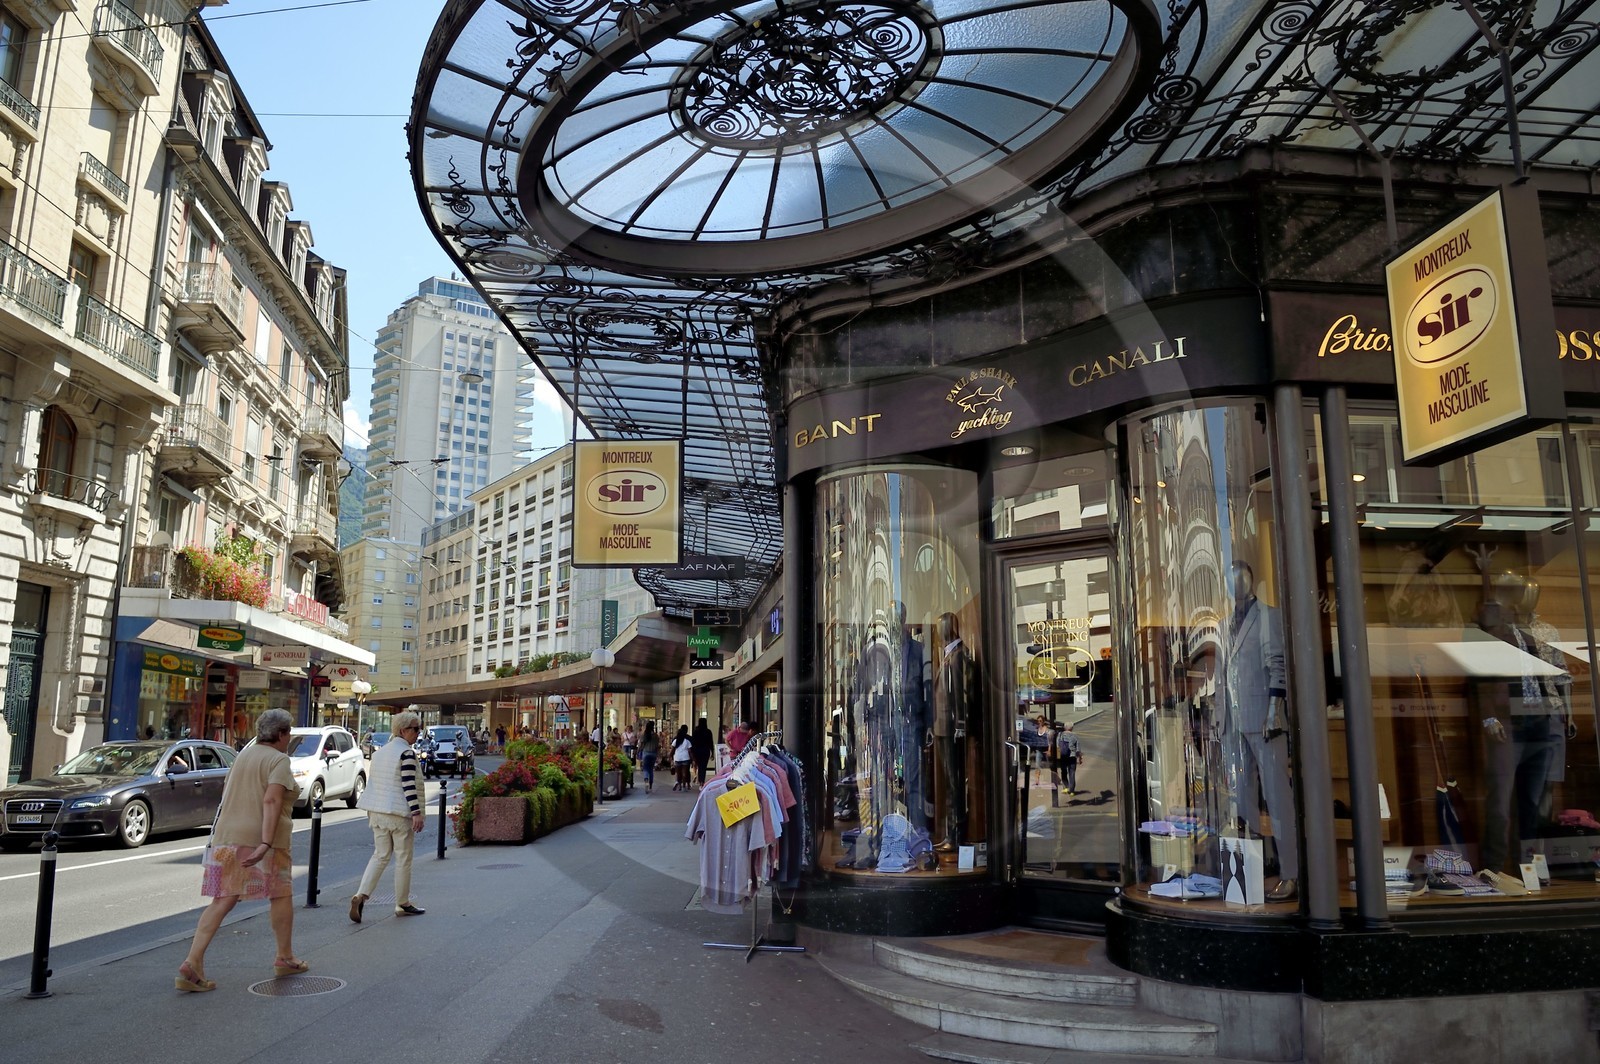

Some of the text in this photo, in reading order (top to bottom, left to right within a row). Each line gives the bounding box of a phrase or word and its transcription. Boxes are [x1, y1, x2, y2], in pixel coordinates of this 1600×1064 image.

[1414, 229, 1472, 283] MONTREUX
[1417, 287, 1483, 348] sir
[1317, 314, 1392, 357] Brio
[1068, 335, 1188, 388] CANALI
[945, 367, 1018, 403] PAUL & SHARK
[1439, 362, 1472, 396] MODE
[1428, 379, 1490, 425] MASCULINE
[793, 412, 883, 449] GANT
[950, 407, 1013, 439] yachting
[602, 451, 653, 464] MONTREUX
[598, 478, 657, 502] sir
[599, 536, 652, 549] MASCULINE
[612, 523, 640, 536] MODE
[706, 563, 736, 571] NAF
[1027, 617, 1093, 633] MONTREUX
[1032, 630, 1089, 644] KNITTING
[273, 651, 306, 659] GENERALI
[1038, 656, 1087, 680] sir
